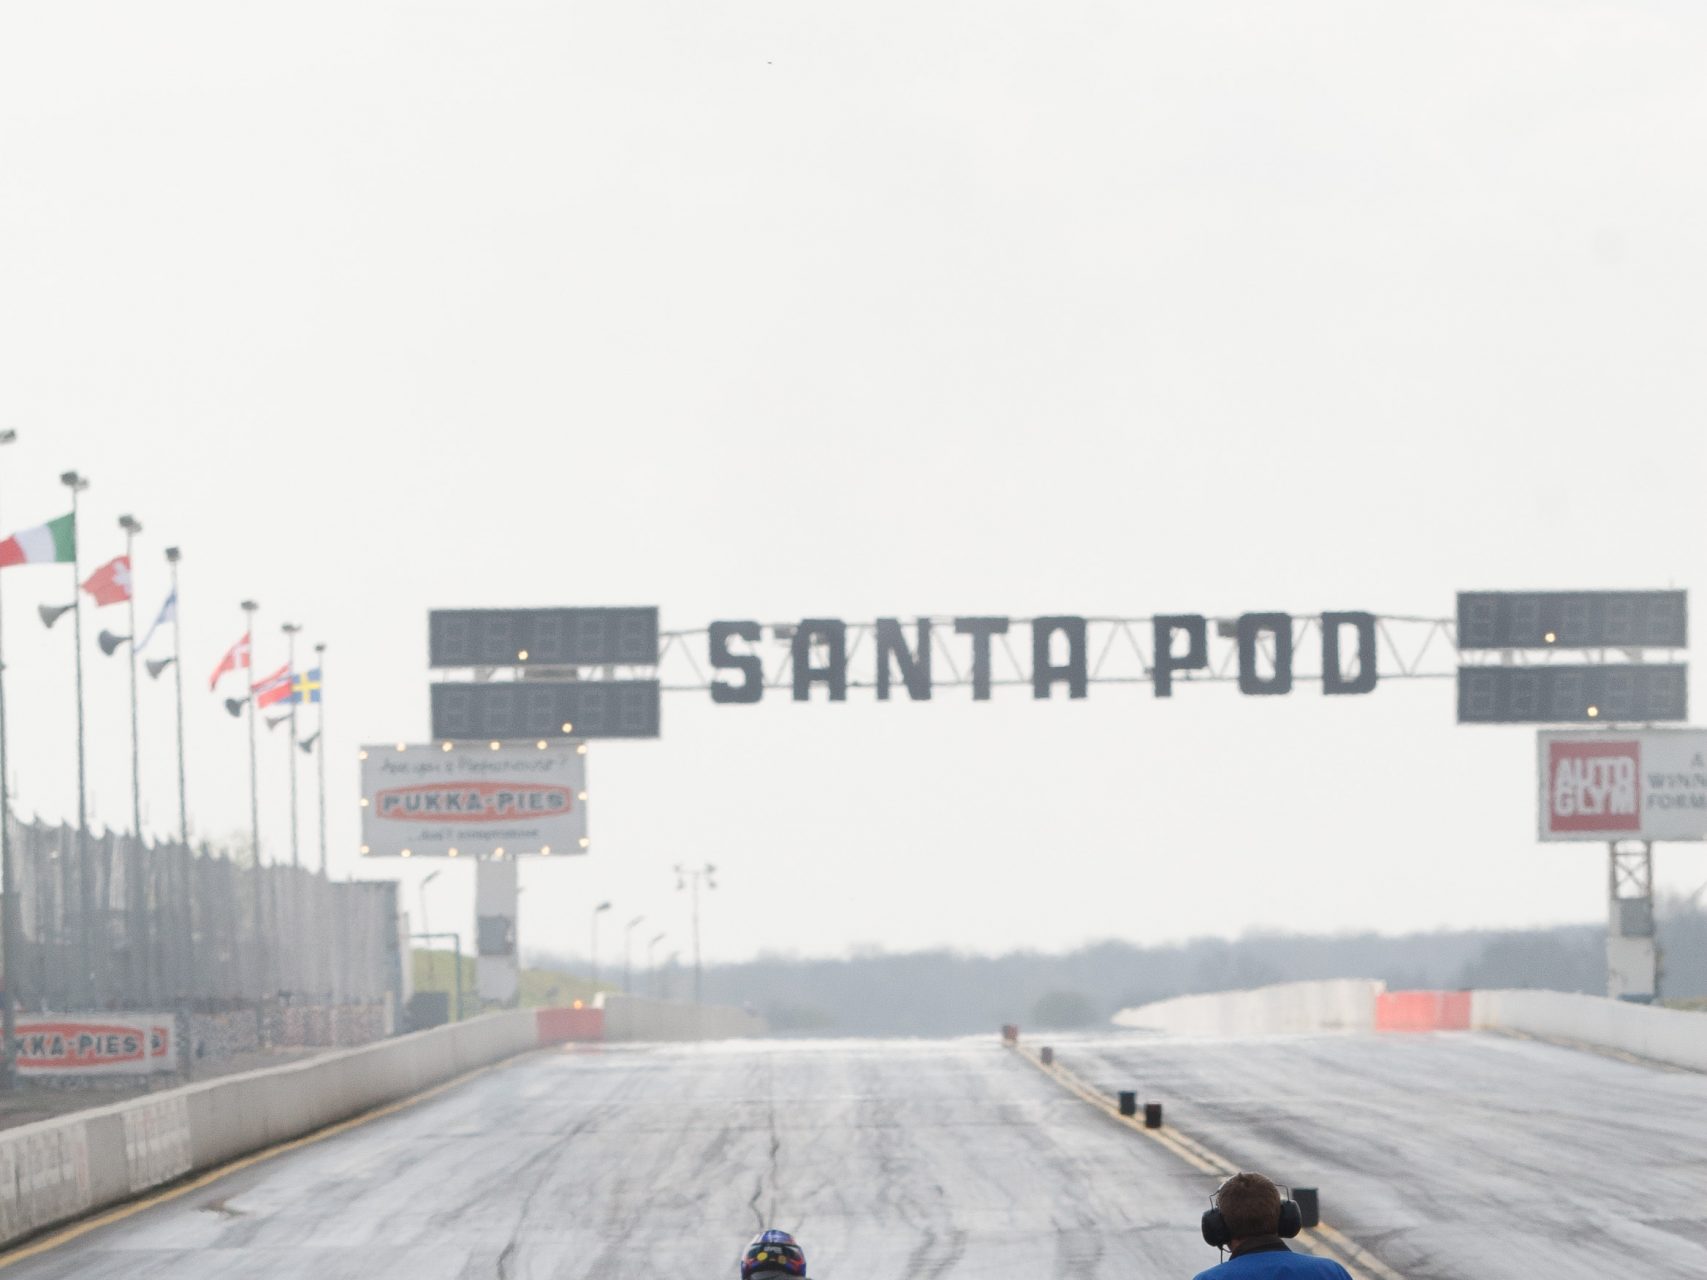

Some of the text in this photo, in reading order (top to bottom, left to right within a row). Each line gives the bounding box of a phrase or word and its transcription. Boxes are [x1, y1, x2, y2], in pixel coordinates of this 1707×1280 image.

[709, 611, 1377, 704] SANTA POD
[1556, 756, 1636, 788] AUTO
[383, 790, 564, 813] PUKKA-PIES
